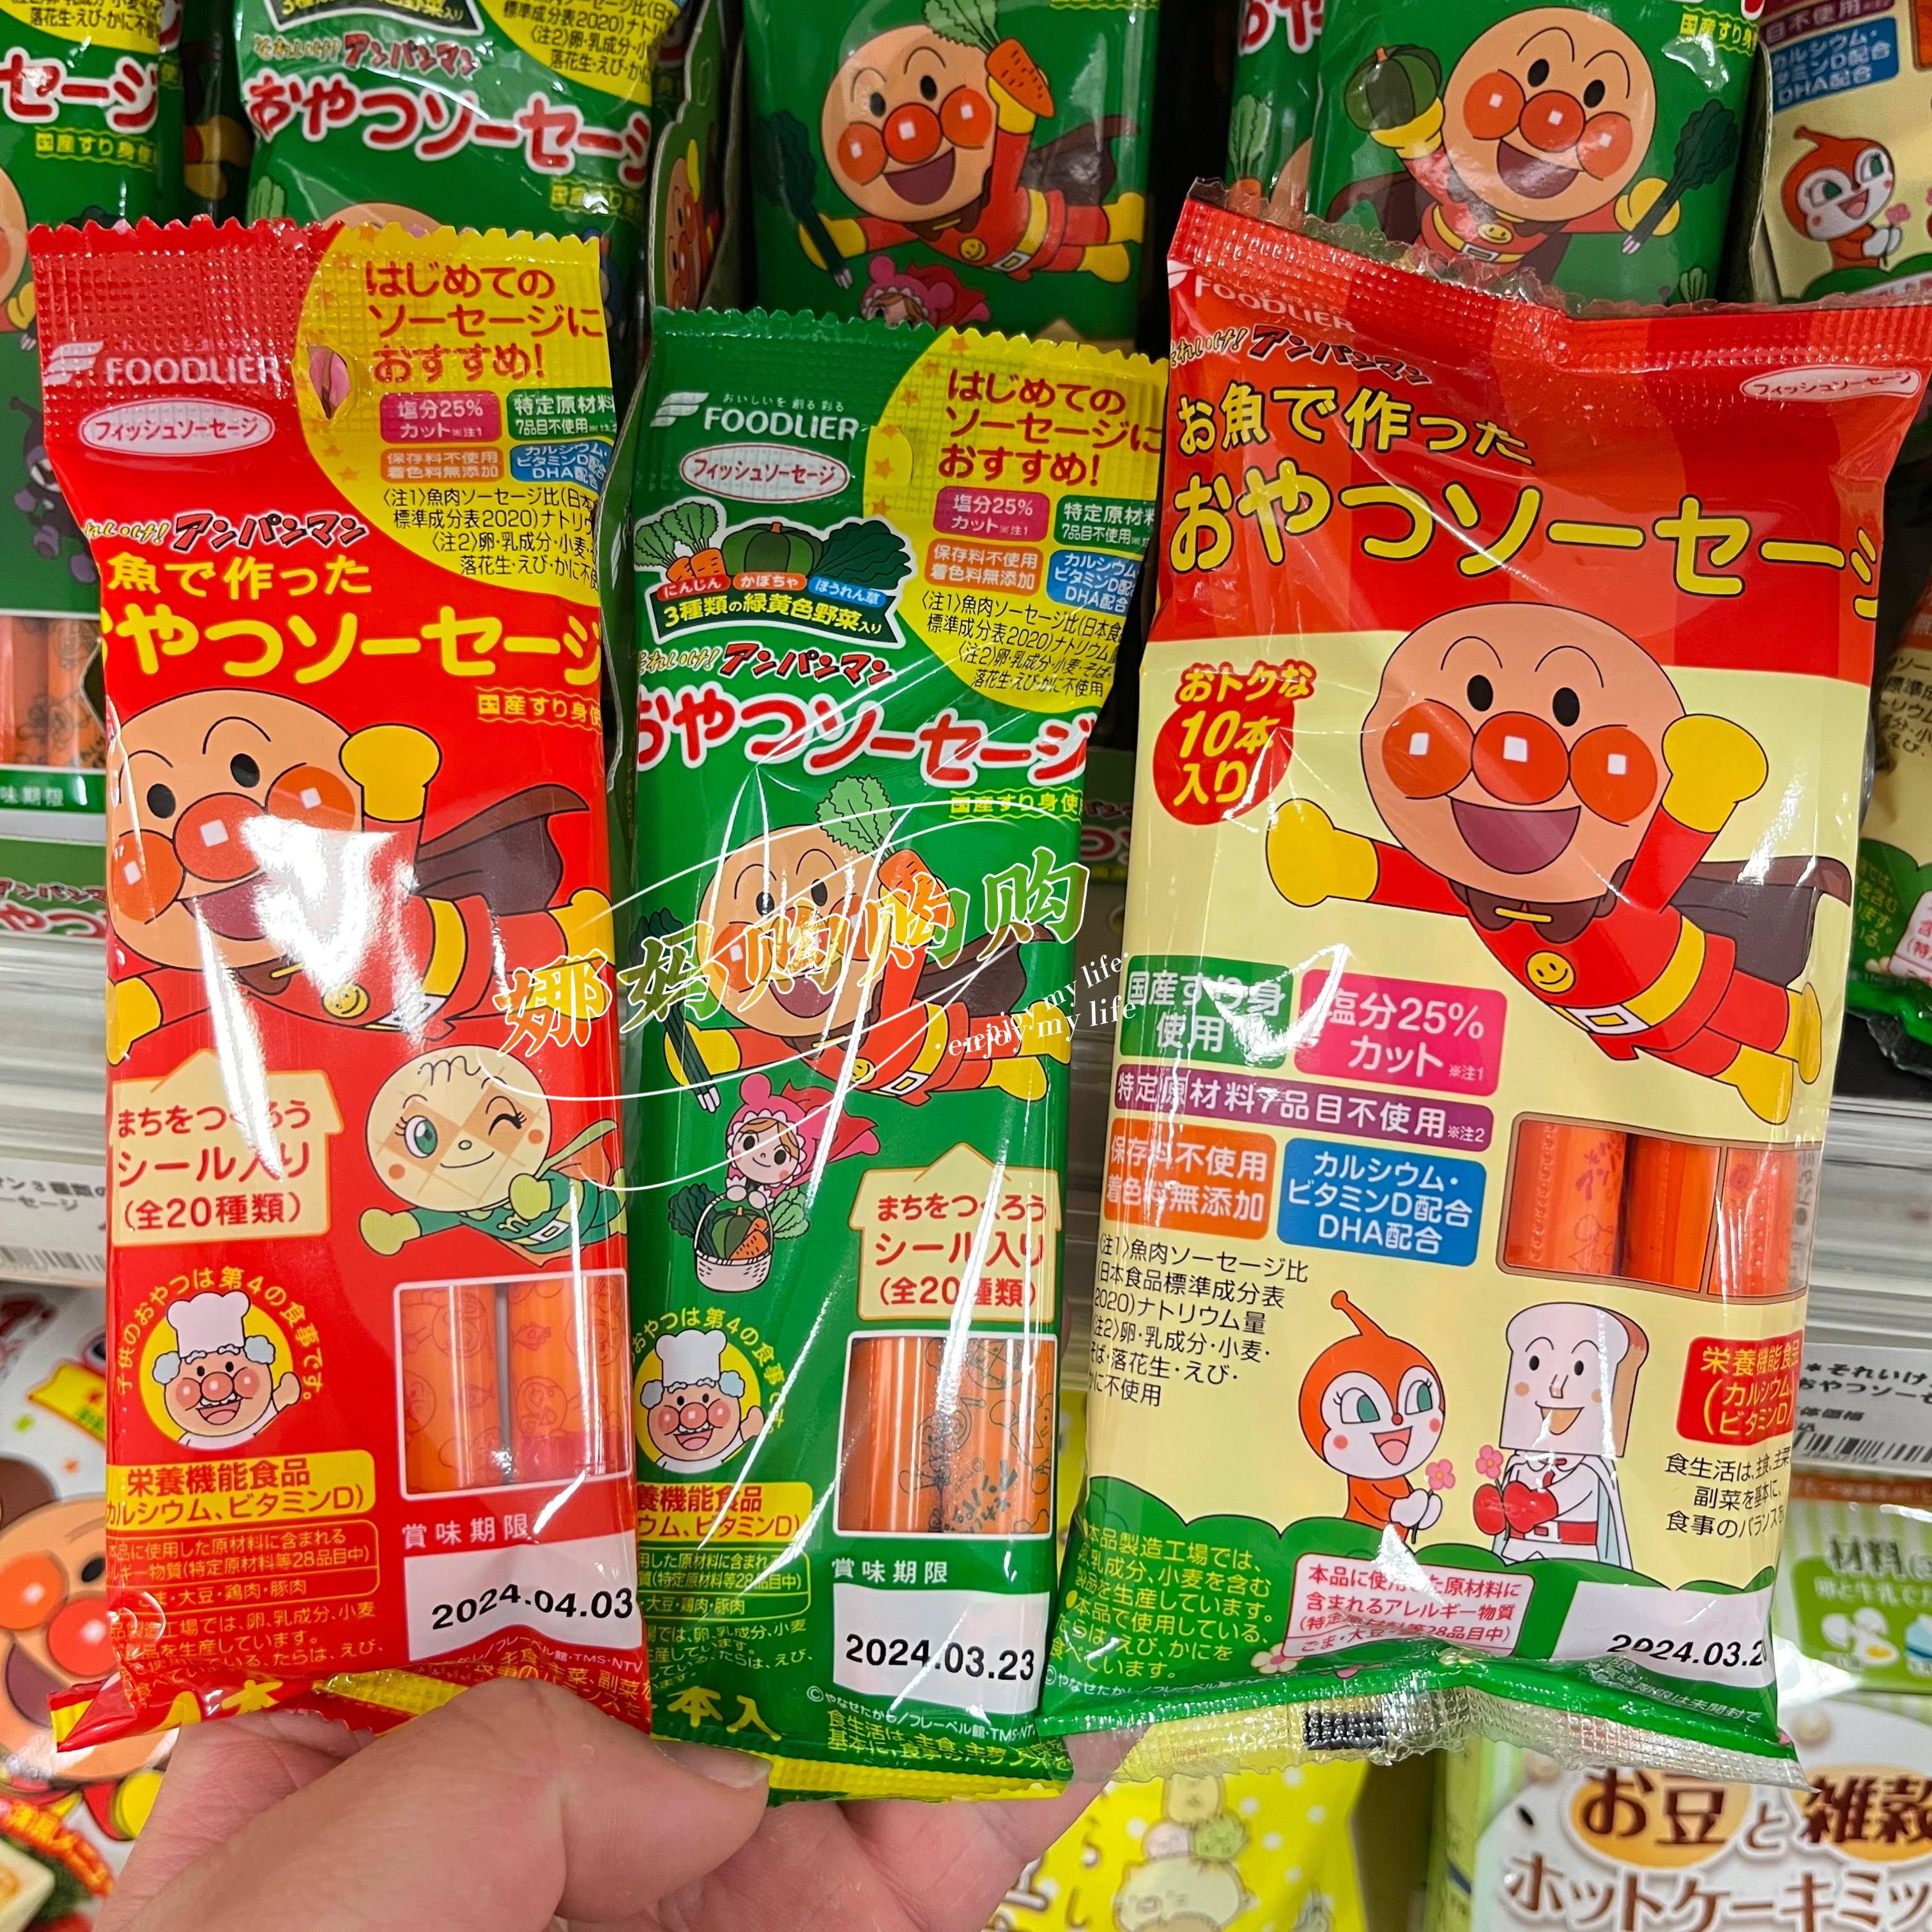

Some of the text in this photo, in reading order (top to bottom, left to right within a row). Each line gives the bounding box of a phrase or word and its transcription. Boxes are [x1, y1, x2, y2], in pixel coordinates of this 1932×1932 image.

[367, 261, 555, 298] はじめての
[368, 304, 603, 338] ソーセージに
[1195, 275, 1356, 332] FOODLIER
[106, 357, 282, 385] FOODLIER
[373, 343, 544, 383] おすすめ!
[397, 398, 484, 420] 塩分25%
[948, 369, 1126, 415] はじめての
[95, 417, 260, 441] フィッシュソーセージ
[703, 406, 859, 441] FOODLIER
[946, 407, 1162, 454] ソーセージに
[1177, 381, 1535, 466] お魚で作った
[387, 452, 499, 465] 保存料不使用
[694, 459, 836, 486] フィッシュソーセージ
[939, 443, 1100, 487] おすすめ!
[953, 494, 1033, 517] 塩分25%
[172, 509, 369, 552] アンパンマン
[108, 551, 372, 600] 魚で作った
[930, 564, 1035, 590] 着色料無添加
[933, 544, 1038, 570] 保存料不使用
[664, 578, 722, 597] にんじん
[740, 575, 799, 588] かぼちゃ
[816, 579, 881, 606] ほうれん草
[1065, 586, 1128, 613] DHA配合
[664, 593, 882, 634] 3種類の緑黄色野菜入り
[102, 603, 601, 685] やつソーセージ
[719, 642, 897, 686] アンパンマン
[1179, 664, 1314, 702] おトクな
[1179, 710, 1280, 758] 10本
[1173, 760, 1247, 806] 入り
[1156, 1011, 1225, 1054] 使用
[1328, 987, 1485, 1039] 塩分25%
[118, 1100, 310, 1138] まちをつろう
[1108, 1134, 1268, 1181] 保存料不使用
[125, 1191, 300, 1231] (全20種類)
[1289, 1181, 1473, 1228] ビタミンD配合
[1318, 1214, 1443, 1255] DHA配合
[880, 1276, 1036, 1308] (全20種類)
[1098, 1260, 1285, 1308] (日本食品標準成分表
[1094, 1287, 1266, 1335] 2020)ナトリウム量
[128, 1458, 310, 1498] 栄養機能食品
[402, 1514, 528, 1549] 賞味期限
[639, 1553, 782, 1569] 用した原材料に含まれ
[831, 1558, 947, 1584] 賞味期限
[432, 1583, 633, 1630] 2024.04.03
[1074, 1596, 1268, 1644] 本品で使用している、
[1306, 1591, 1515, 1621] 含まれるアレルギー物質
[845, 1634, 1035, 1680] 2024.03.23
[1607, 1634, 1767, 1667] 2024.03.2
